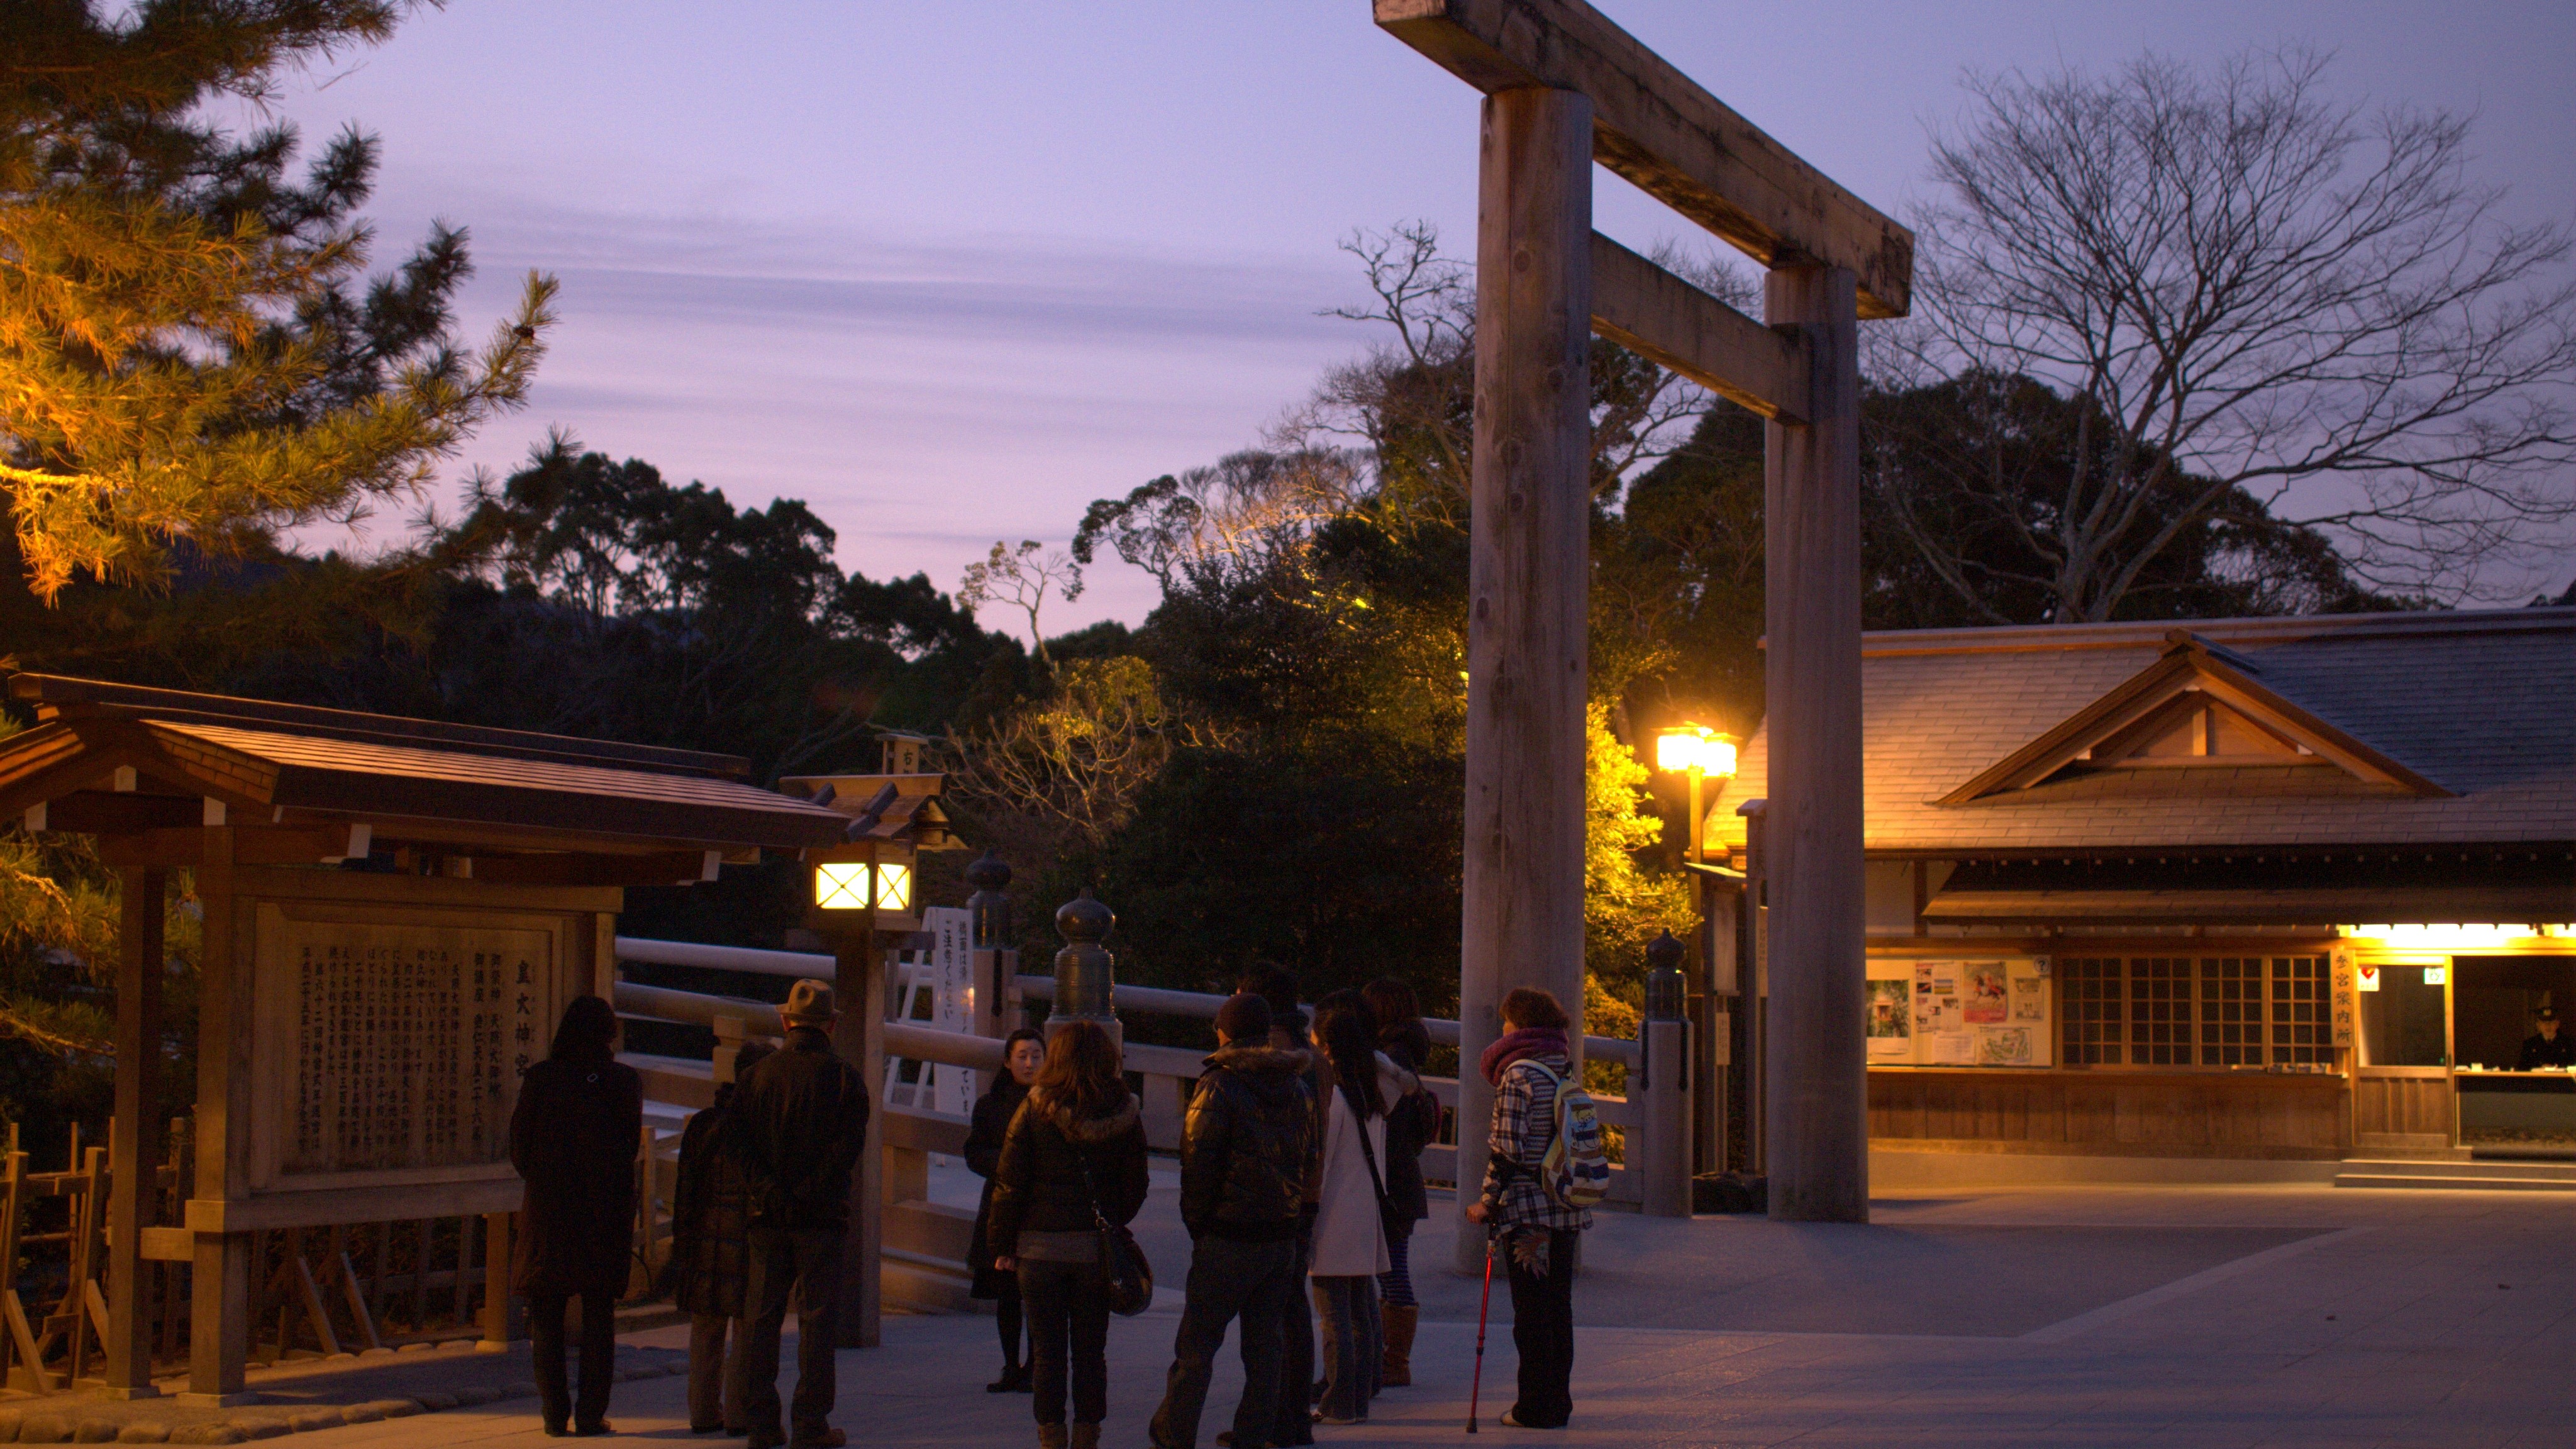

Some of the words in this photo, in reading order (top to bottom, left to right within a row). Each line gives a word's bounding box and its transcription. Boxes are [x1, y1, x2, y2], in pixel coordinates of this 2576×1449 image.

[903, 748, 913, 774] 右
[514, 959, 531, 1078] 皇大神宮
[2335, 954, 2351, 1041] 参宮案内所
